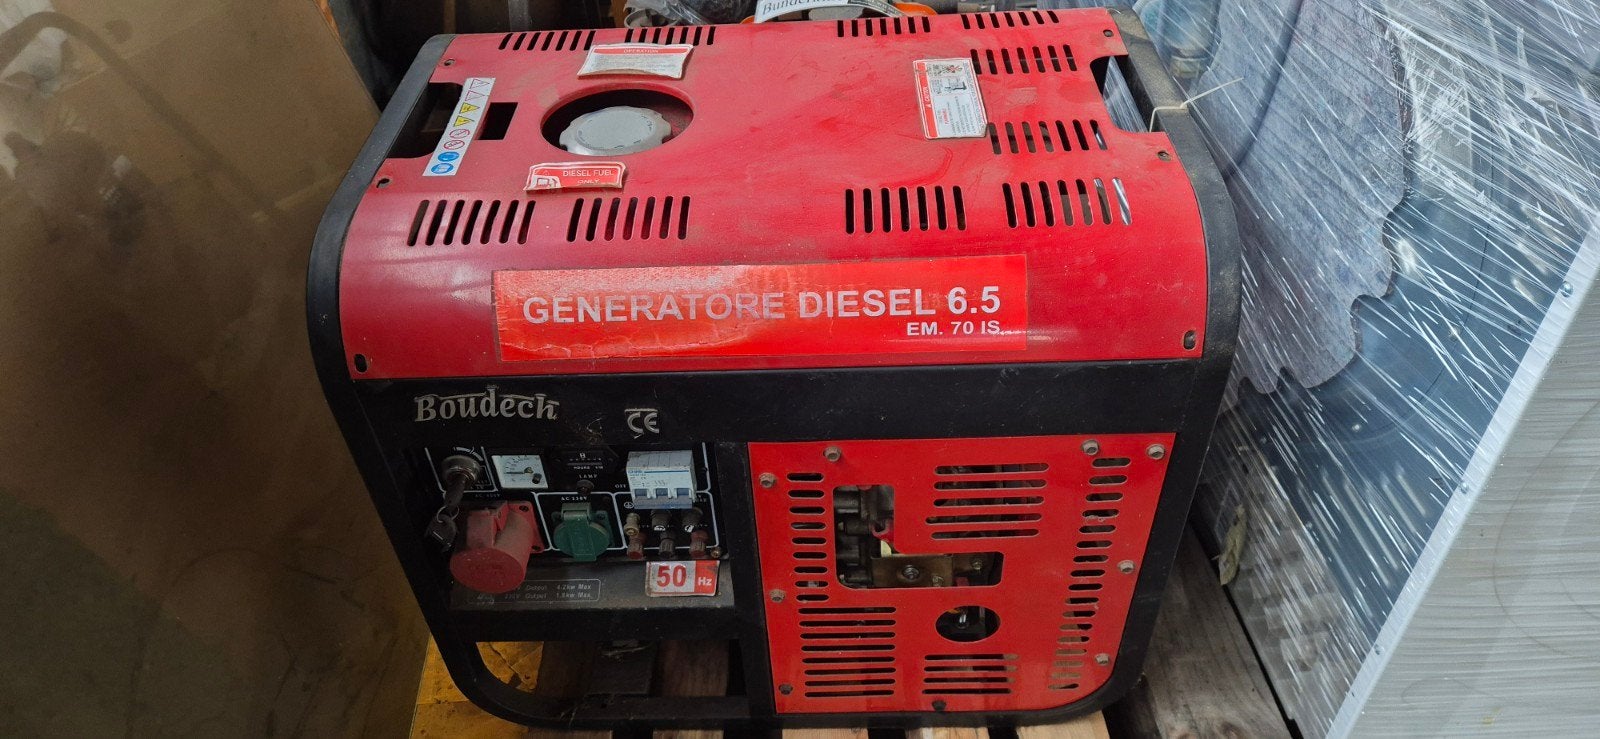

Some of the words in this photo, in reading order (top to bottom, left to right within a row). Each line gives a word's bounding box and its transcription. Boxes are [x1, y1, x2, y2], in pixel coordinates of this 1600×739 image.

[593, 169, 614, 177] FUEL
[523, 293, 786, 324] GENERATORE
[799, 288, 936, 318] DIESEL
[947, 286, 1001, 315] 6.5
[907, 321, 943, 336] EM.
[950, 321, 974, 335] 70
[414, 386, 559, 422] Boudech
[626, 411, 660, 435] CE
[656, 564, 687, 587] 50
[698, 577, 712, 586] Hz
